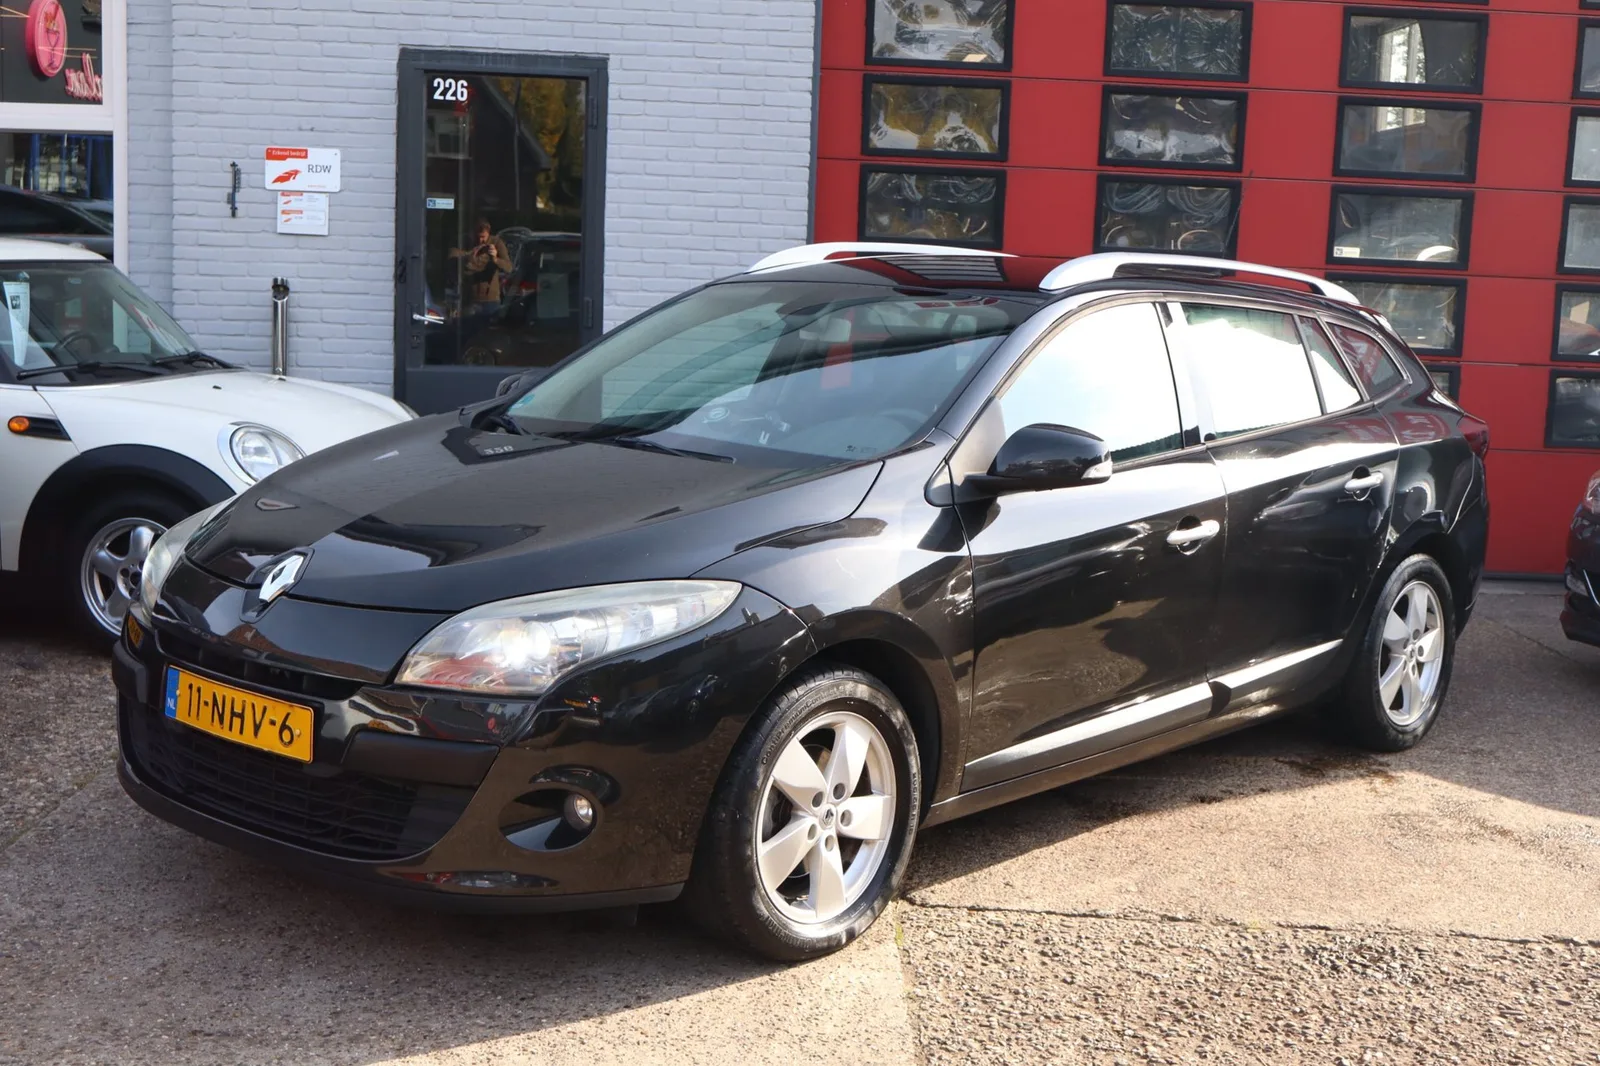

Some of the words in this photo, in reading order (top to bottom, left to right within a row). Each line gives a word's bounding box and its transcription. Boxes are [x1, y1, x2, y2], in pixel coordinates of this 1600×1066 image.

[433, 77, 468, 102] 226
[307, 164, 332, 174] RDW
[167, 698, 176, 710] NL
[187, 682, 295, 748] 11-NHV-6
